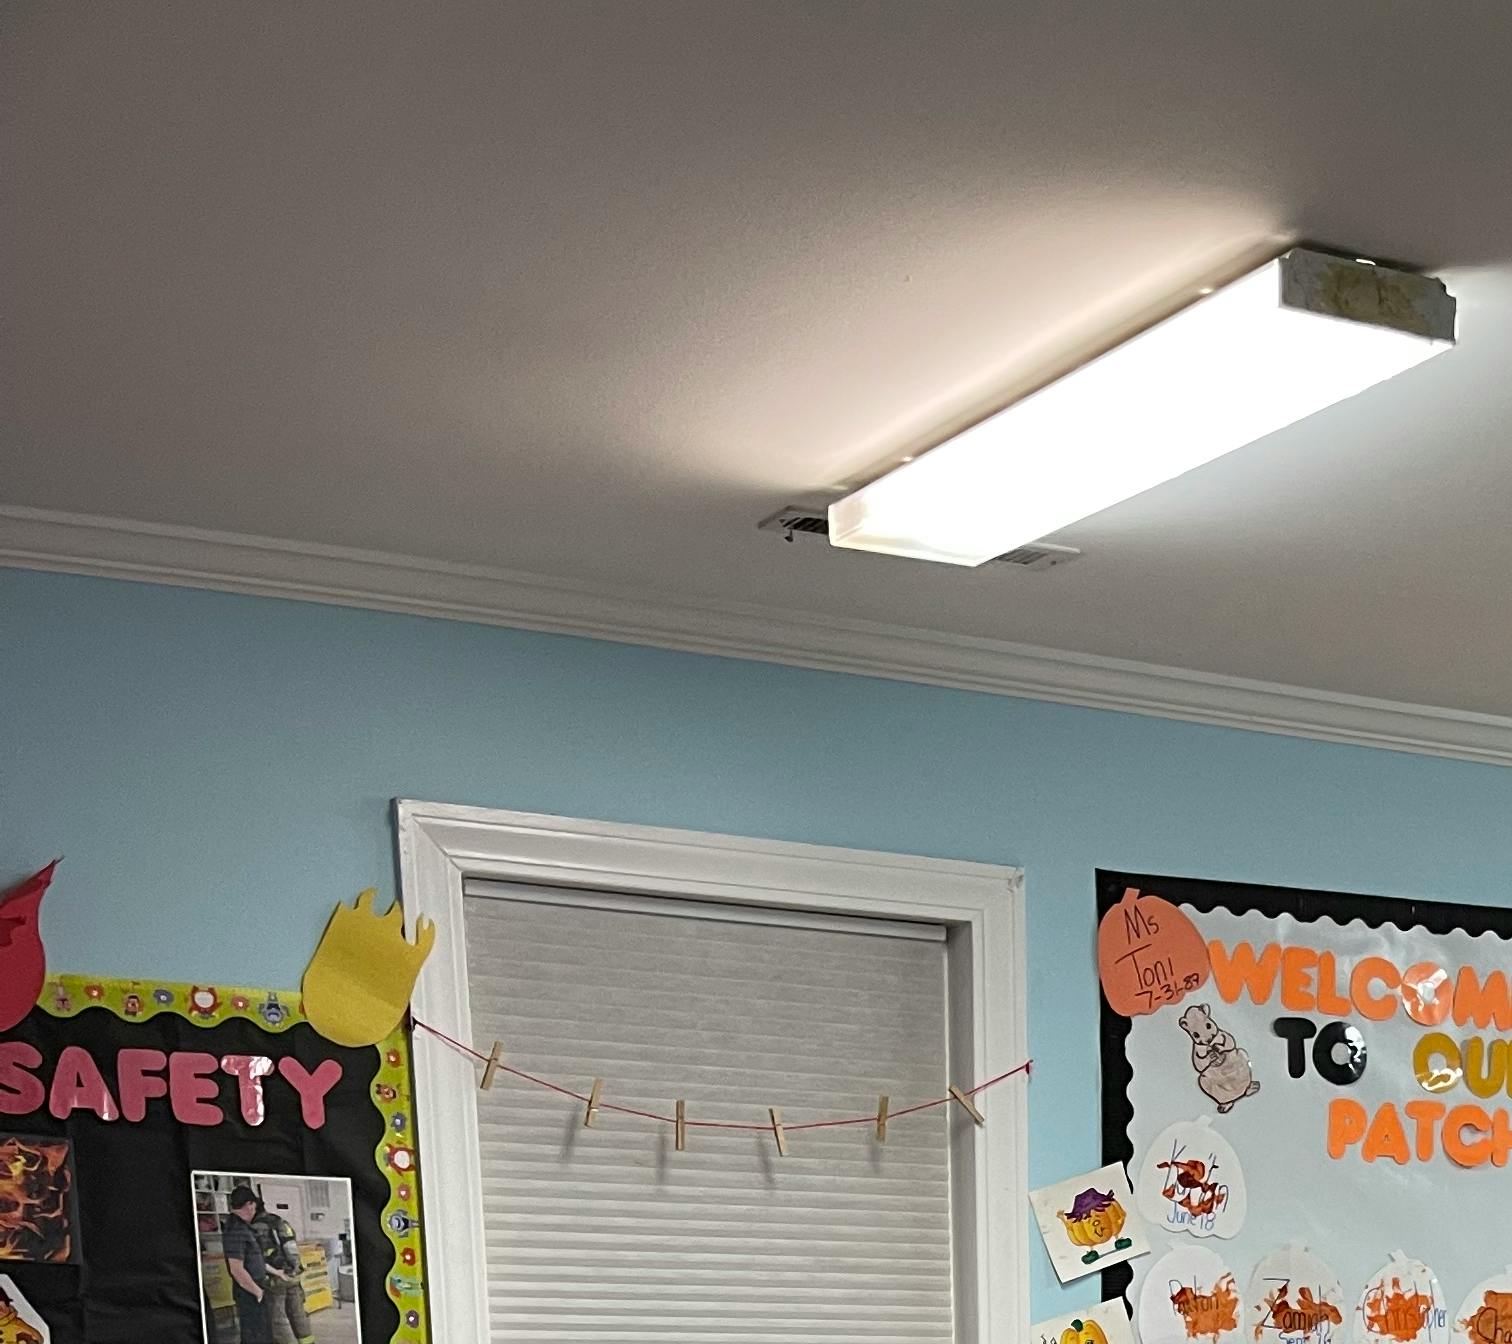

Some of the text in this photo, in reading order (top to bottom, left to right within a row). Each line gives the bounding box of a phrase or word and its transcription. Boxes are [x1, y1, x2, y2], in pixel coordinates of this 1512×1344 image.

[1124, 904, 1160, 945] Ms
[1115, 943, 1174, 990] Toni
[1274, 1016, 1368, 1086] TO
[0, 1041, 345, 1130] SAFETY
[1167, 1201, 1198, 1226] June
